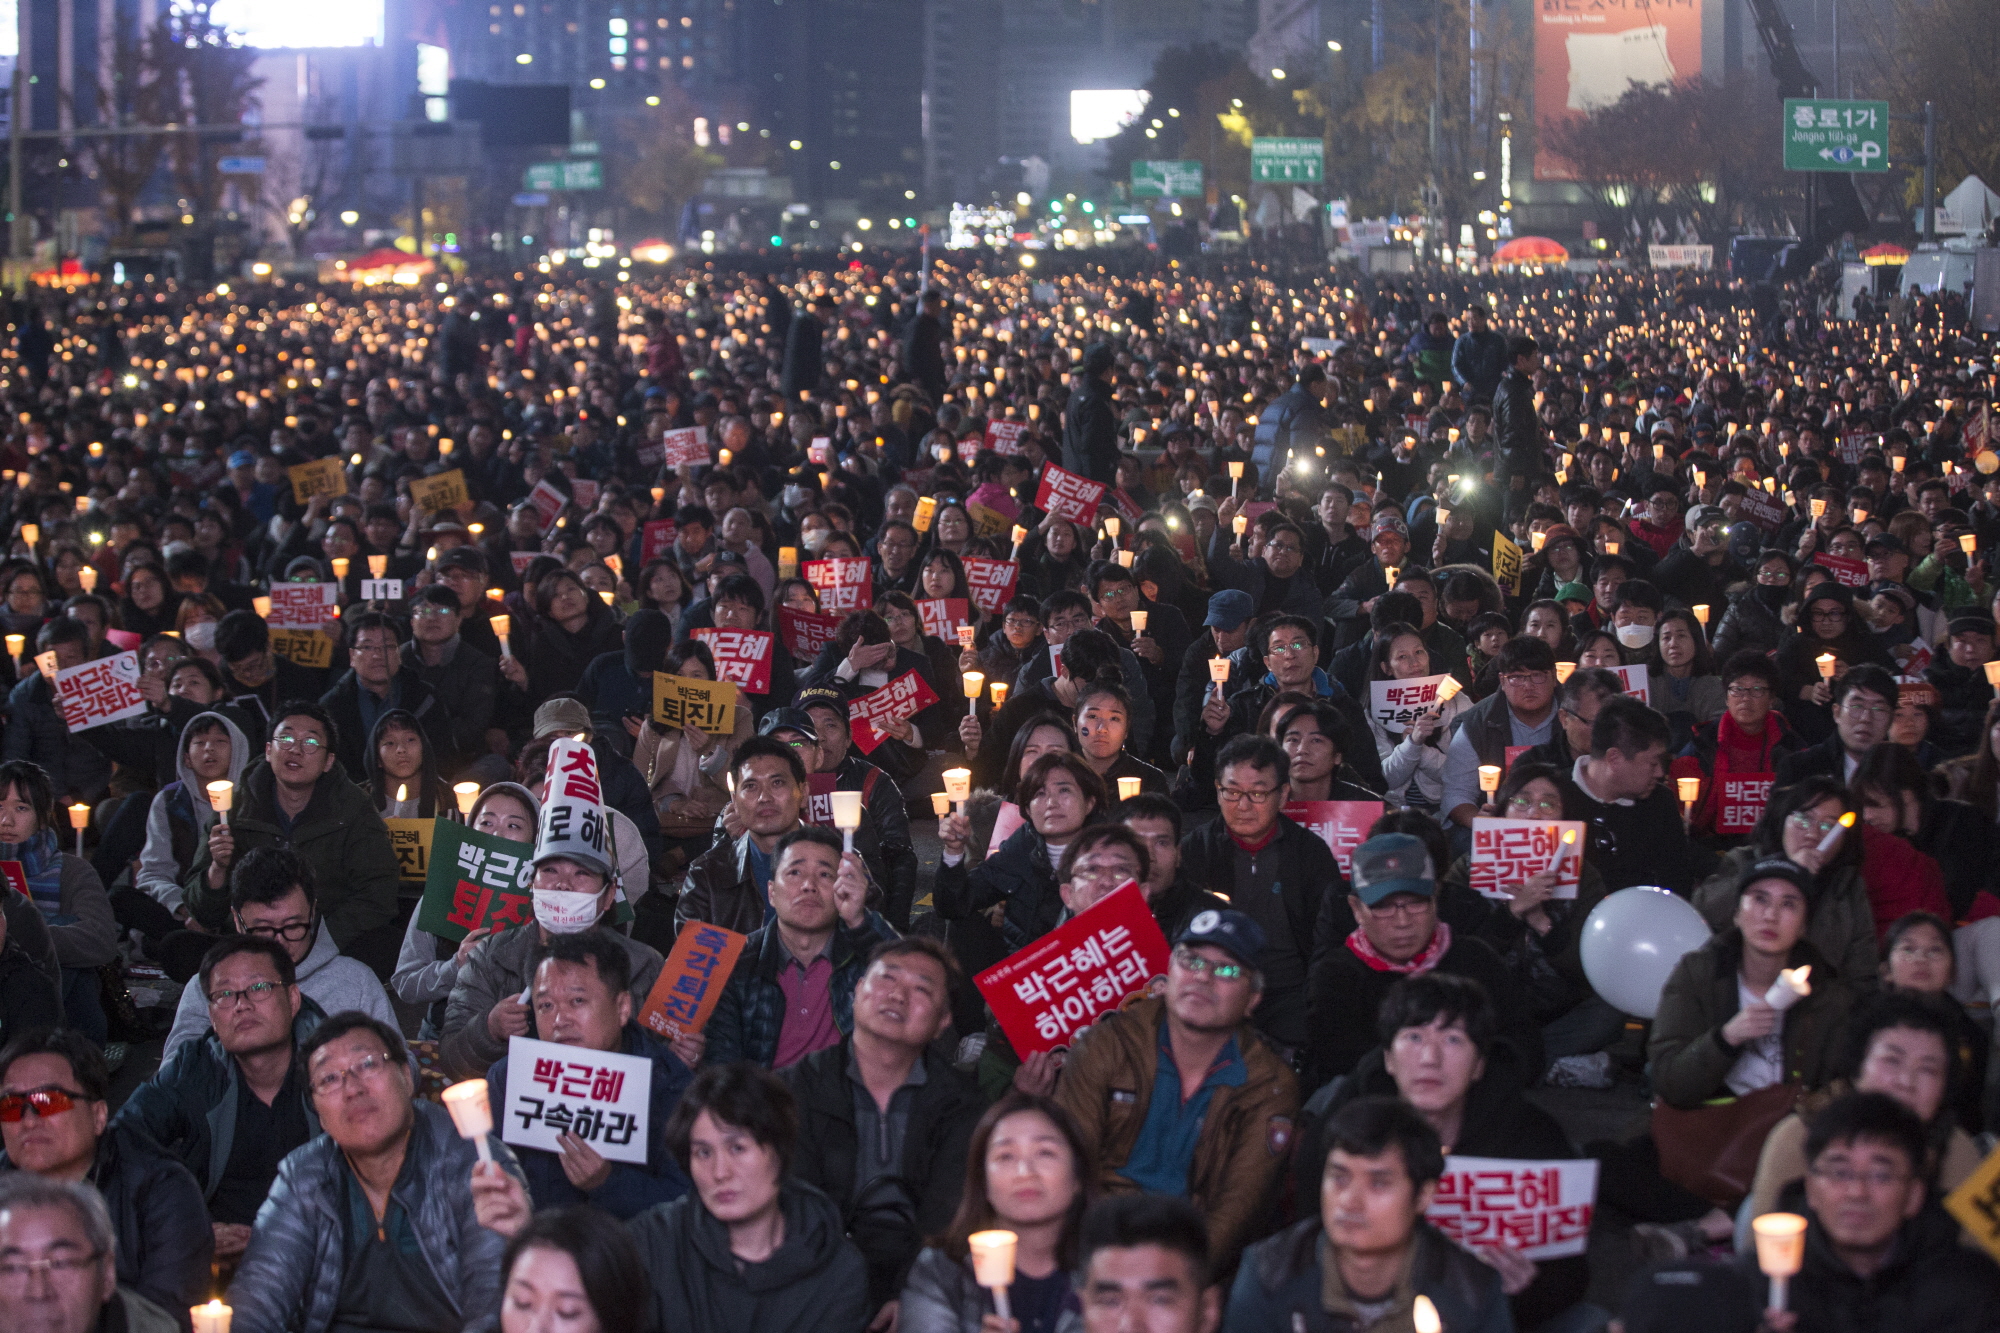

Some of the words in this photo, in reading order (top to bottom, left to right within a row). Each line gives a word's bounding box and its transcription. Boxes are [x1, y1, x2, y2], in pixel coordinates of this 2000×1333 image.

[1793, 106, 1877, 130] 종로1가
[1792, 129, 1825, 146] Jongno
[1045, 467, 1102, 503] 박근혜
[807, 561, 867, 586] 박근혜
[271, 586, 324, 605] 박근혜
[820, 586, 858, 609] 퇴진
[677, 686, 710, 702] 박근혜
[849, 673, 919, 721] 박근혜
[1386, 684, 1438, 706] 박근혜
[662, 697, 725, 732] 퇴진!
[1475, 825, 1559, 860] 박근혜
[663, 927, 728, 1026] 즉각퇴진
[1012, 924, 1134, 1005] 박근혜는
[1035, 950, 1150, 1040] 하야하라
[533, 1057, 625, 1103] 박근혜
[514, 1095, 638, 1145] 구속하라
[1433, 1168, 1560, 1212] 박근혜
